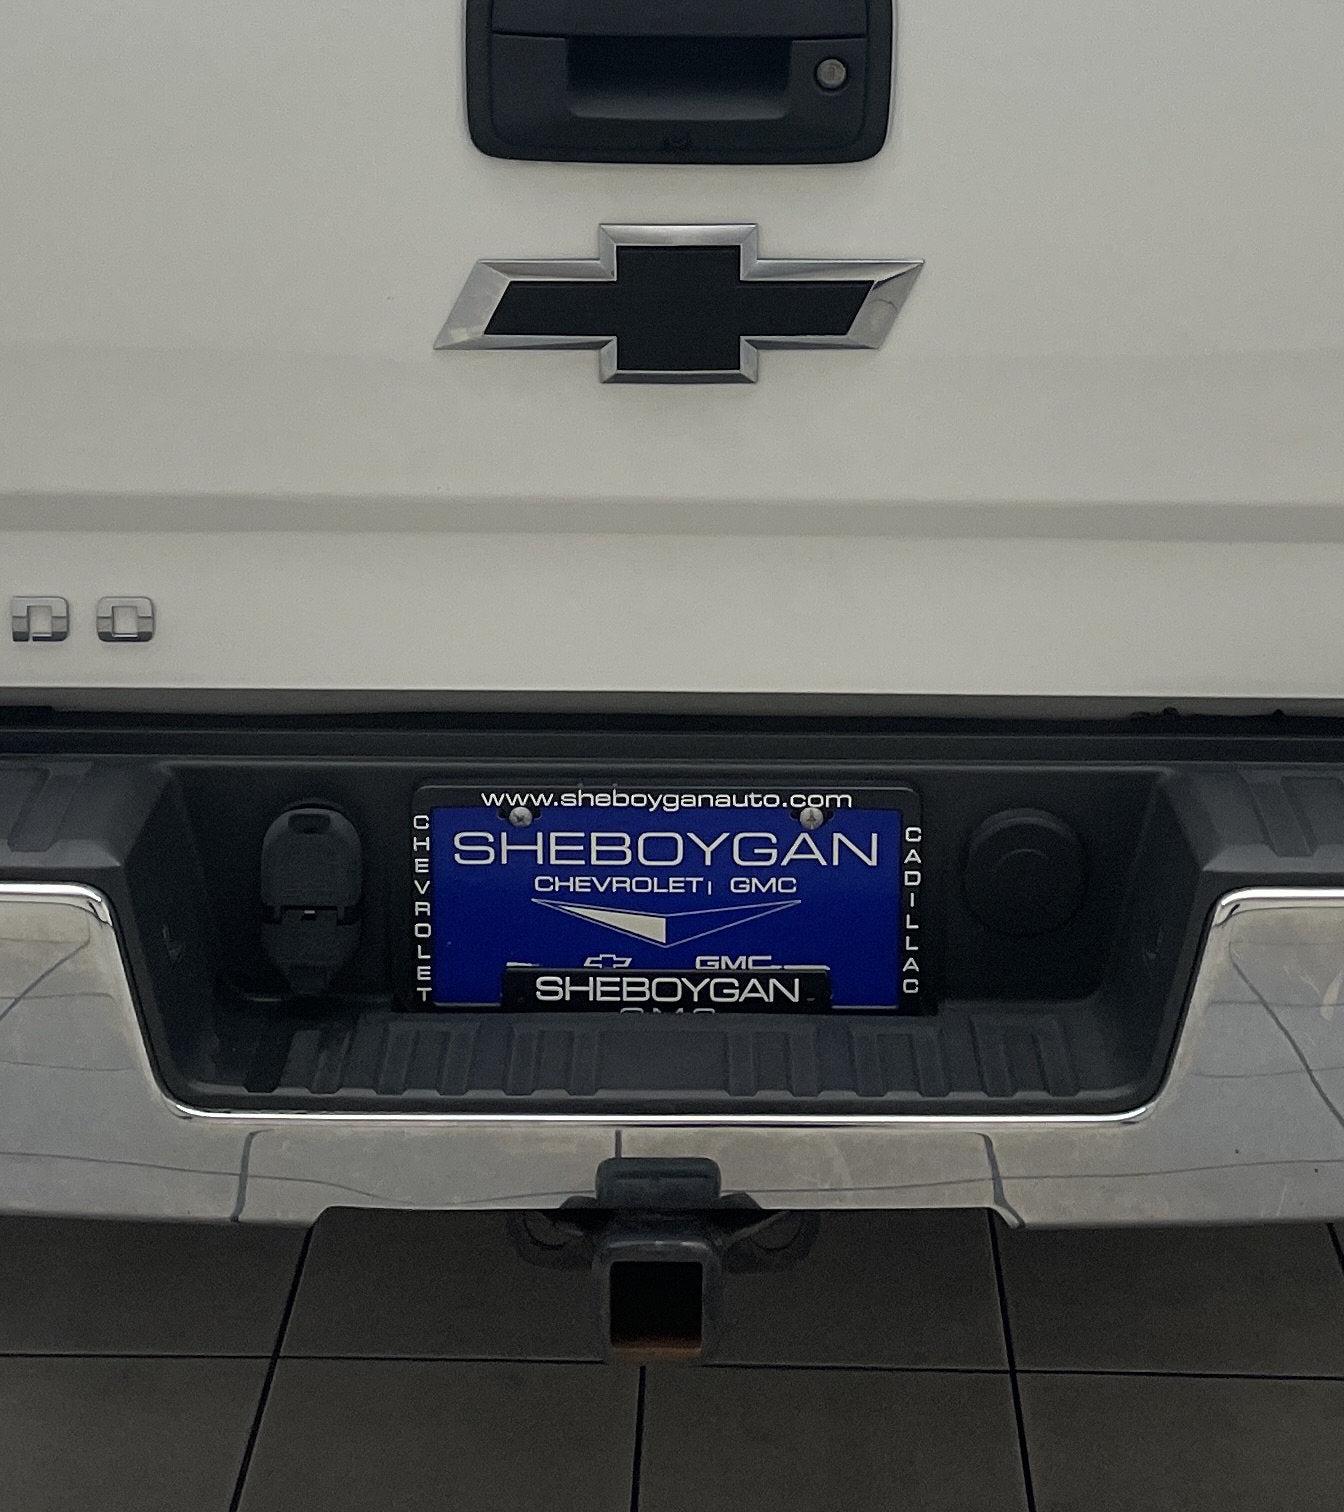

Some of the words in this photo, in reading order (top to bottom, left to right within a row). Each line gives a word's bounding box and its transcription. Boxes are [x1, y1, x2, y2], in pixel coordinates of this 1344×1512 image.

[480, 788, 853, 813] www.sheboyganauto.com
[453, 831, 879, 868] SHEBOYGAN
[729, 876, 798, 894] GMC
[412, 814, 433, 1003] CHEVROLET
[902, 826, 922, 994] CADILLAC
[695, 954, 782, 970] GMC
[535, 975, 800, 1003] SHEBOYGAN
